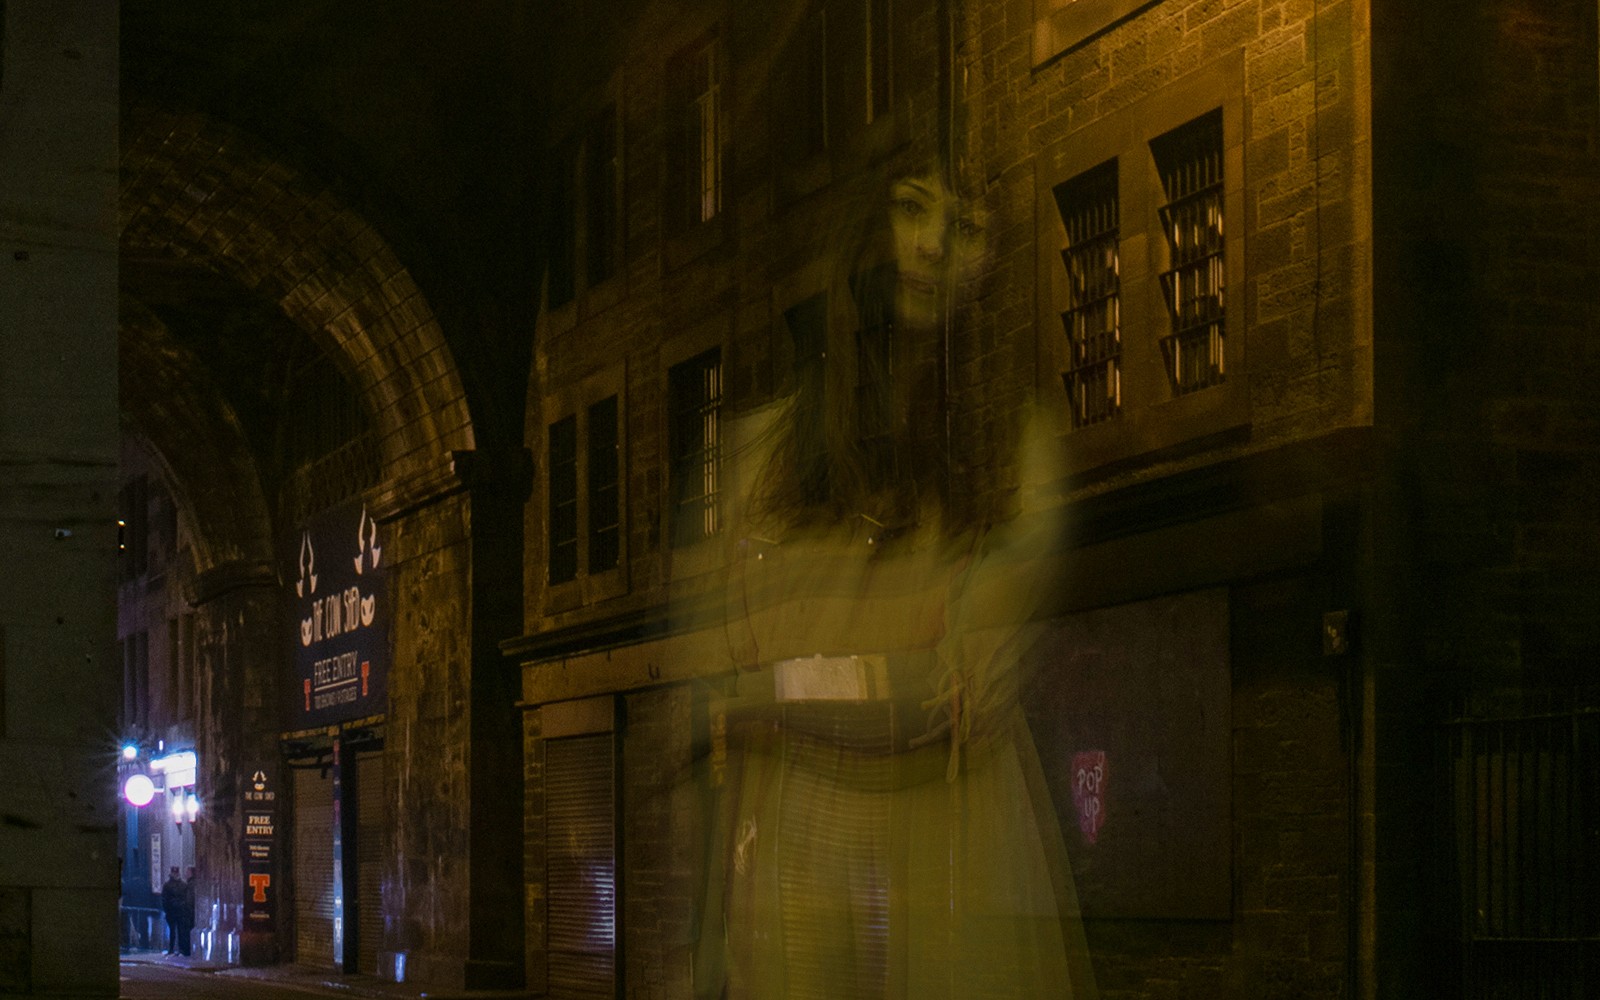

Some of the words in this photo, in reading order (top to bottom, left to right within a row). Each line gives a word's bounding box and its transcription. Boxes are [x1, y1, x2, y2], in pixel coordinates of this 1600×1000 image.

[326, 593, 341, 640] COW
[344, 586, 360, 633] SHED
[314, 659, 331, 687] FREE
[332, 651, 358, 683] ENTRY
[1077, 765, 1103, 796] POP
[246, 825, 274, 835] ENTRY
[248, 815, 271, 825] FREE
[1084, 796, 1100, 833] UP
[249, 873, 271, 903] T
